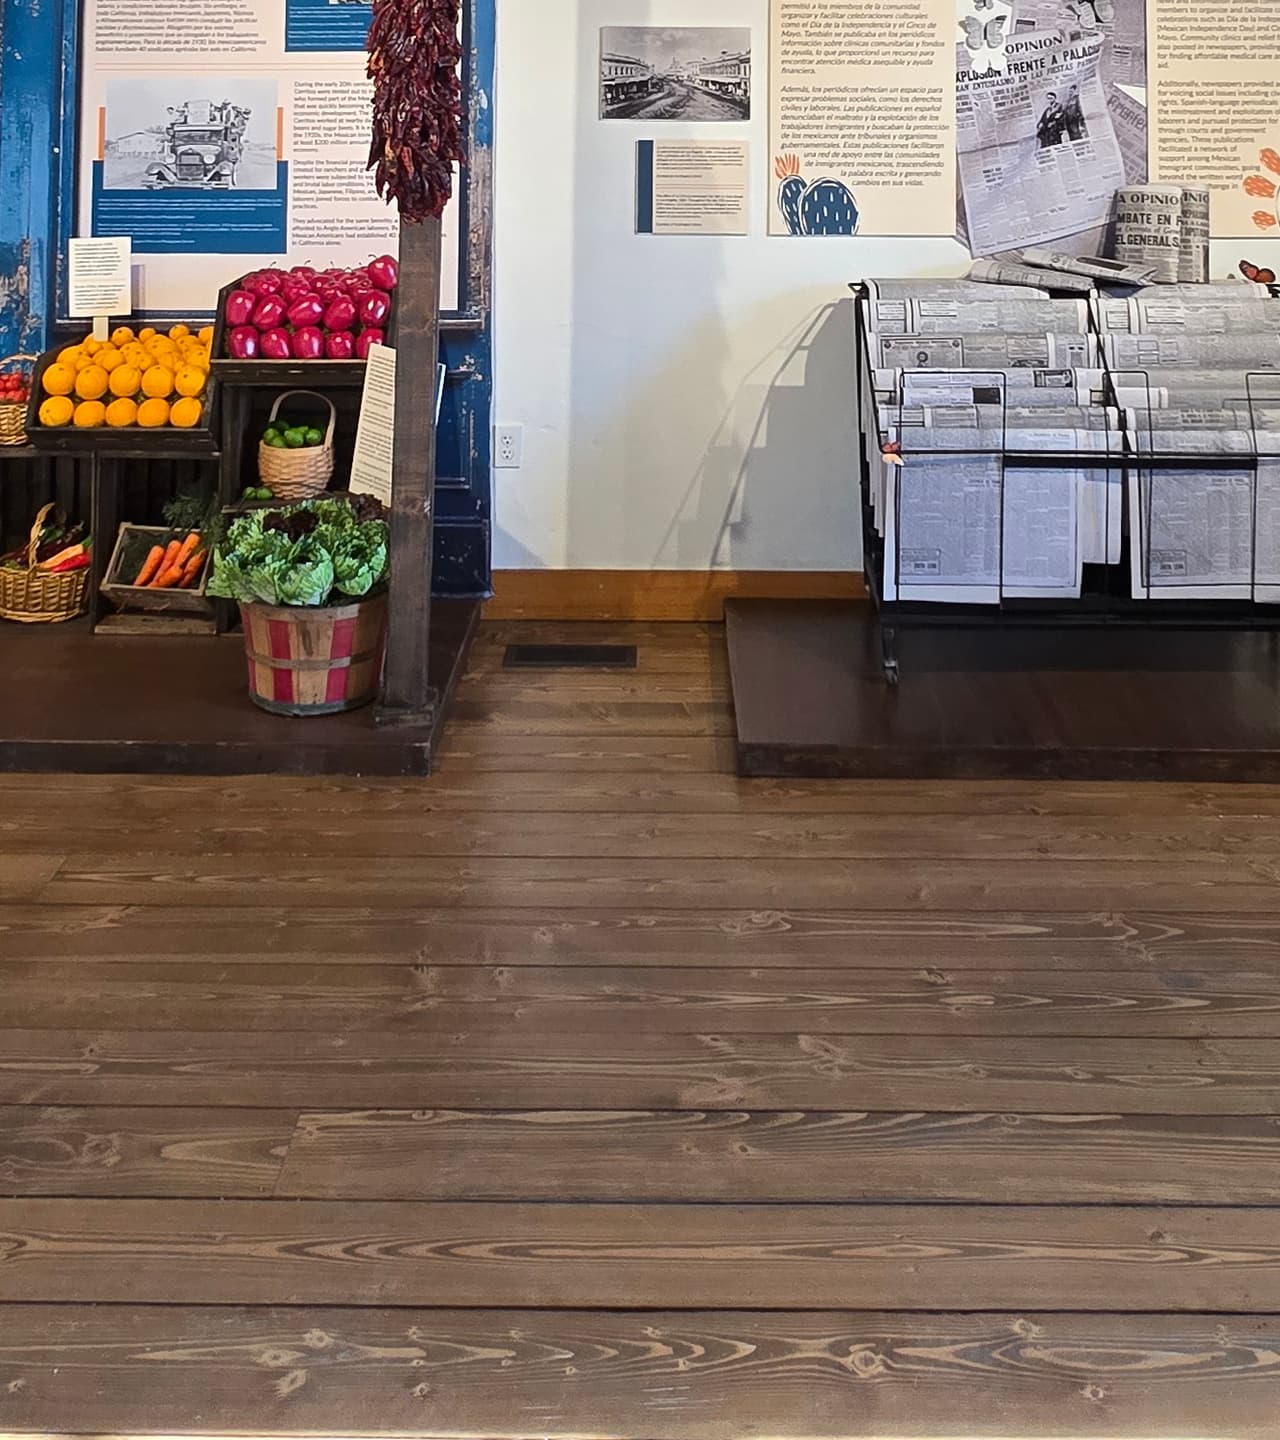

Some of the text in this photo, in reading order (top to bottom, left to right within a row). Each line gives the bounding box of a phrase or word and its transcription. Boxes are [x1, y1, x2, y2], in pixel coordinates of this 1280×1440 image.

[1005, 35, 1063, 54] OPINION
[1007, 58, 1045, 75] FRENTE
[1051, 55, 1058, 65] A
[1031, 70, 1043, 79] LAS
[1047, 63, 1073, 75] FIESTAS
[1157, 214, 1170, 225] EN
